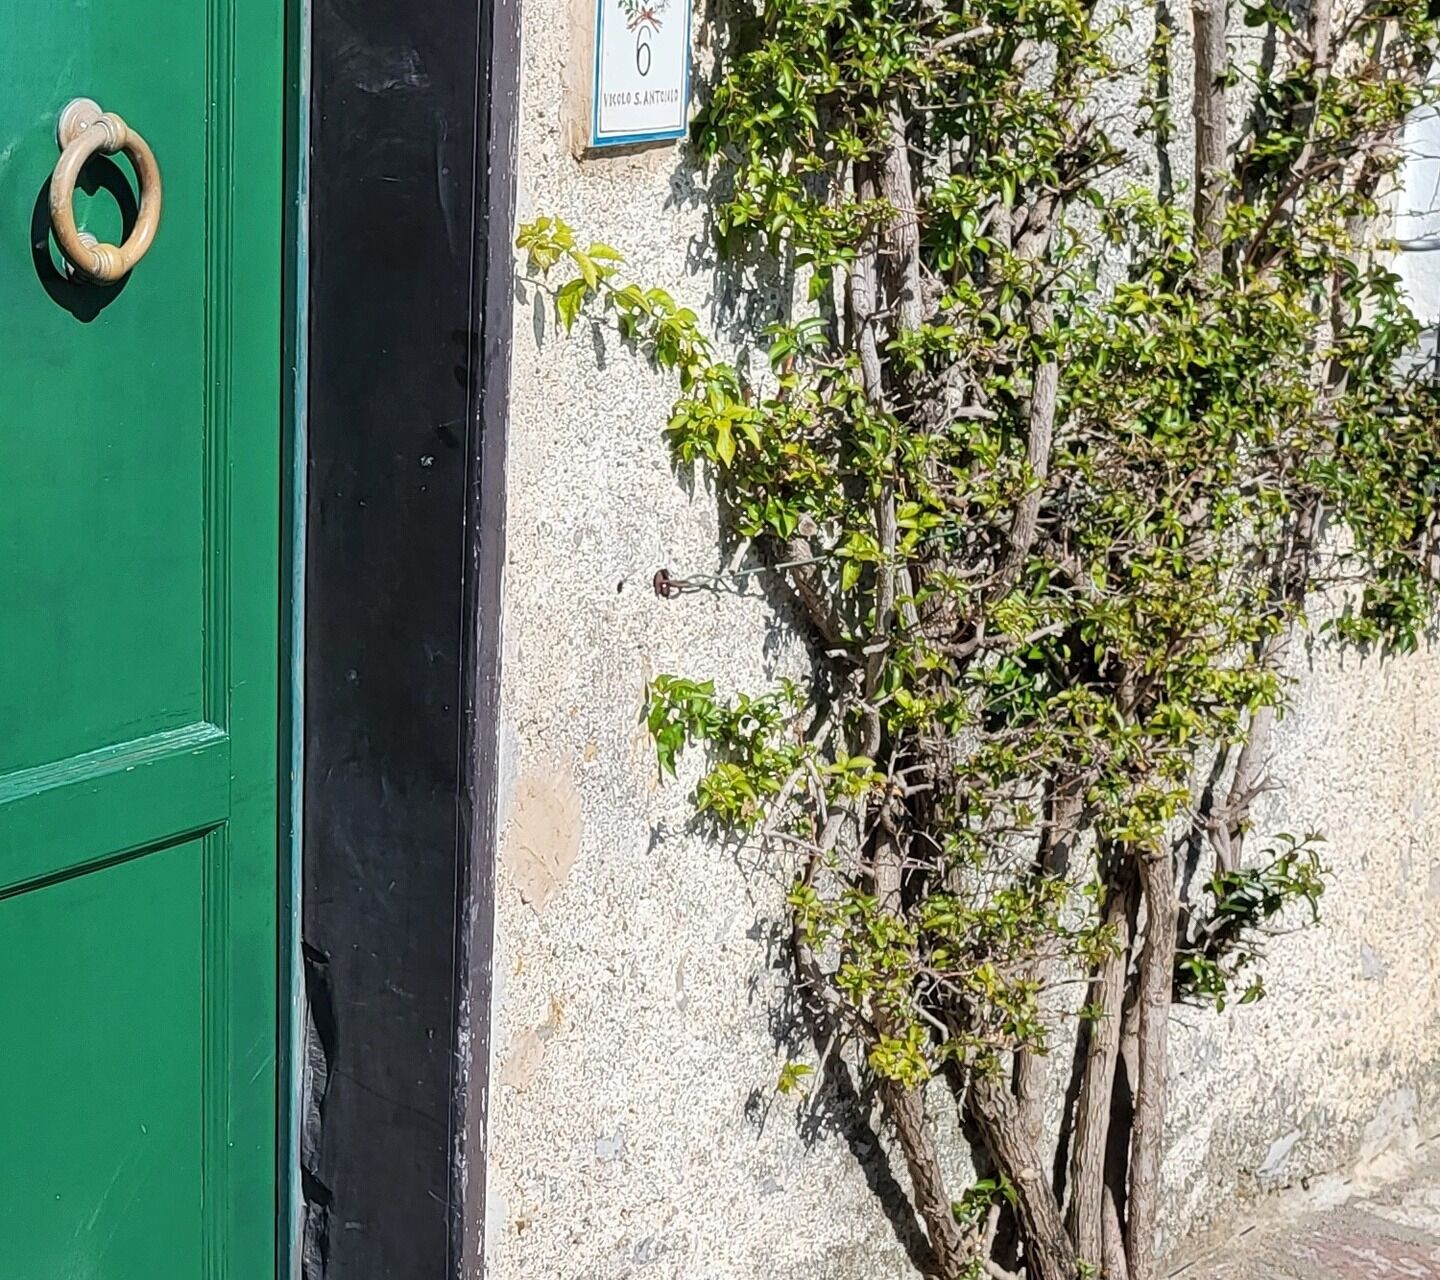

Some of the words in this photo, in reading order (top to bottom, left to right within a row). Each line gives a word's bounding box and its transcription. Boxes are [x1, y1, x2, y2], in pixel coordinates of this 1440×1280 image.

[636, 25, 651, 76] 6
[603, 91, 632, 107] VICOLO
[643, 89, 678, 106] ANTONIO
